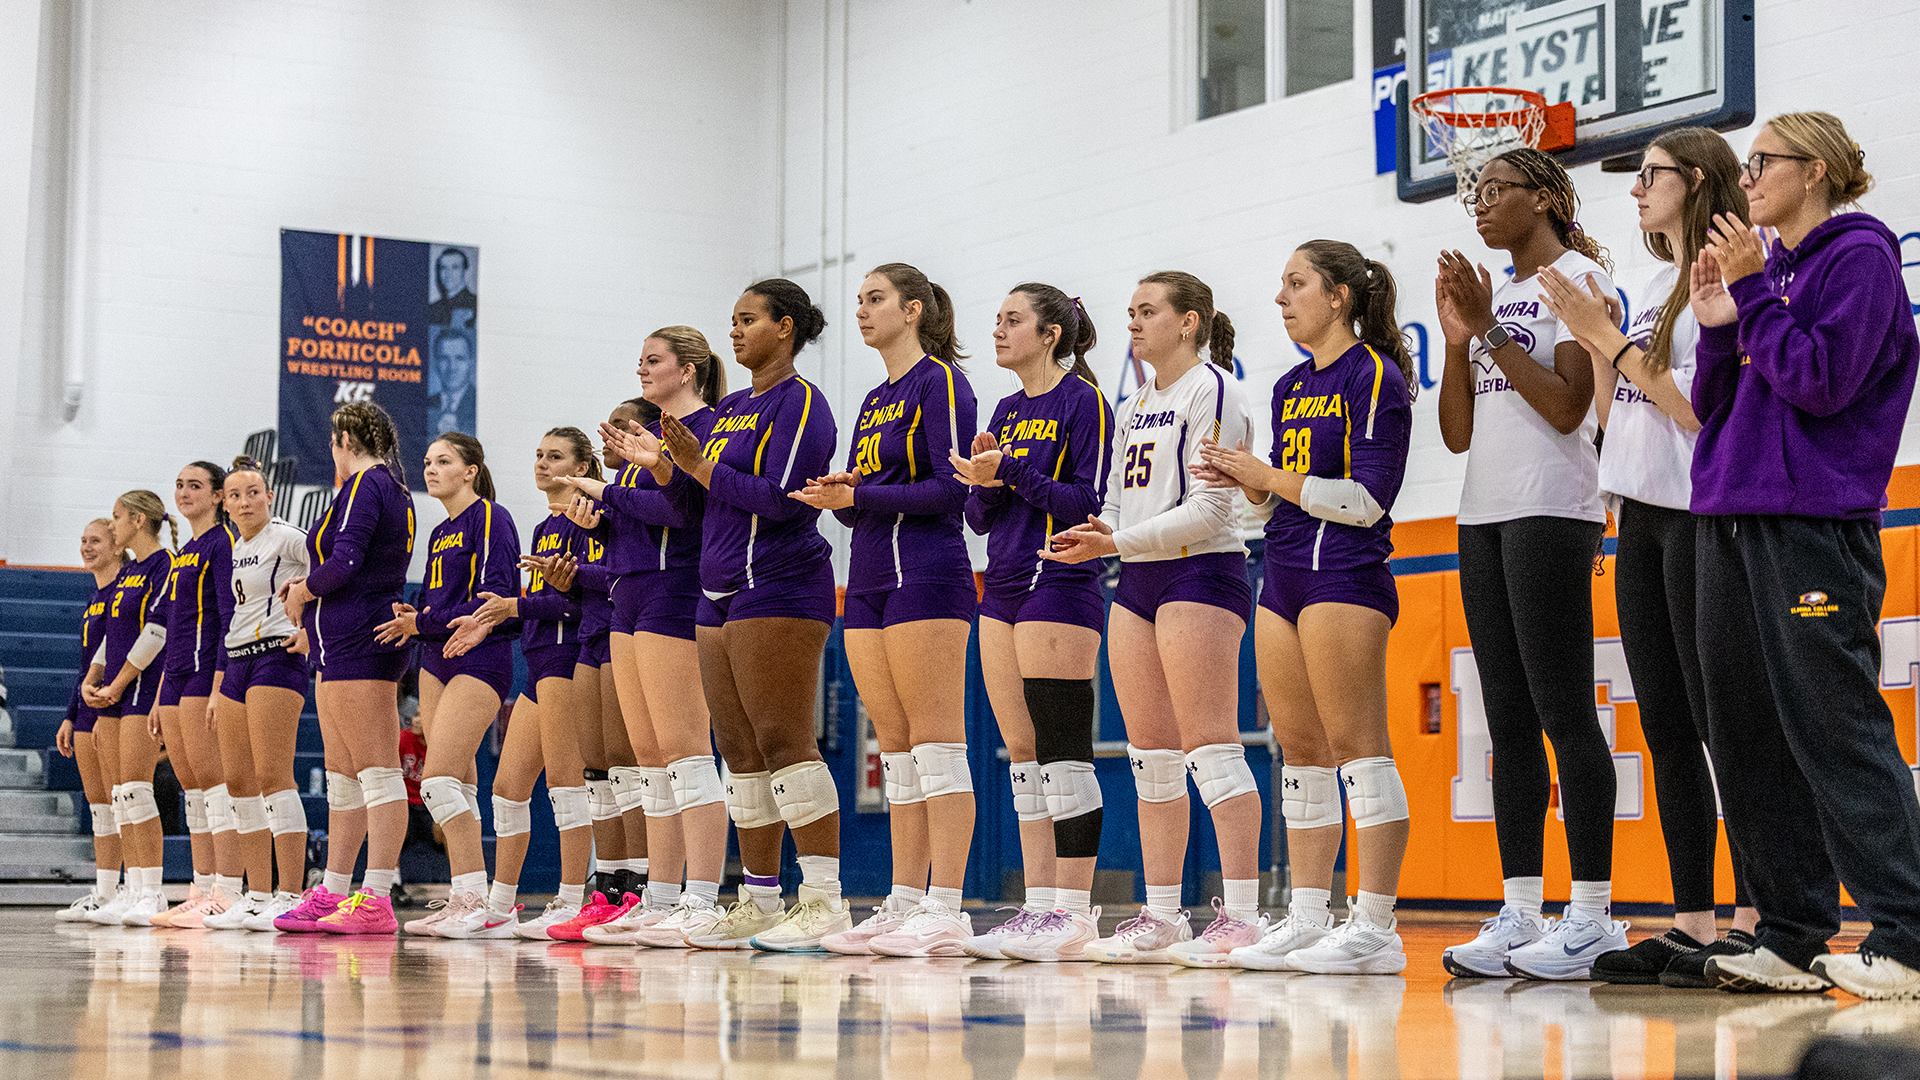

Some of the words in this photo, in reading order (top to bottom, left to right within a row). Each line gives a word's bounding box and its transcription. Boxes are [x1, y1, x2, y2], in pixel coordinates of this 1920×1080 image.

[1463, 0, 1690, 87] KEYSTNE
[1495, 301, 1540, 319] MIRA
[287, 337, 421, 367] FORNICOLA
[287, 360, 373, 379] WRESTLING
[377, 368, 422, 383] ROOM
[860, 400, 905, 431] ELMIRA
[1281, 393, 1342, 423] ELMIRA
[1000, 418, 1058, 447] ELMIRA
[856, 432, 882, 477] 20
[1123, 441, 1156, 490] 25
[1281, 427, 1312, 474] 28
[429, 556, 443, 589] 11
[111, 591, 124, 618] 2
[235, 578, 246, 606] 8
